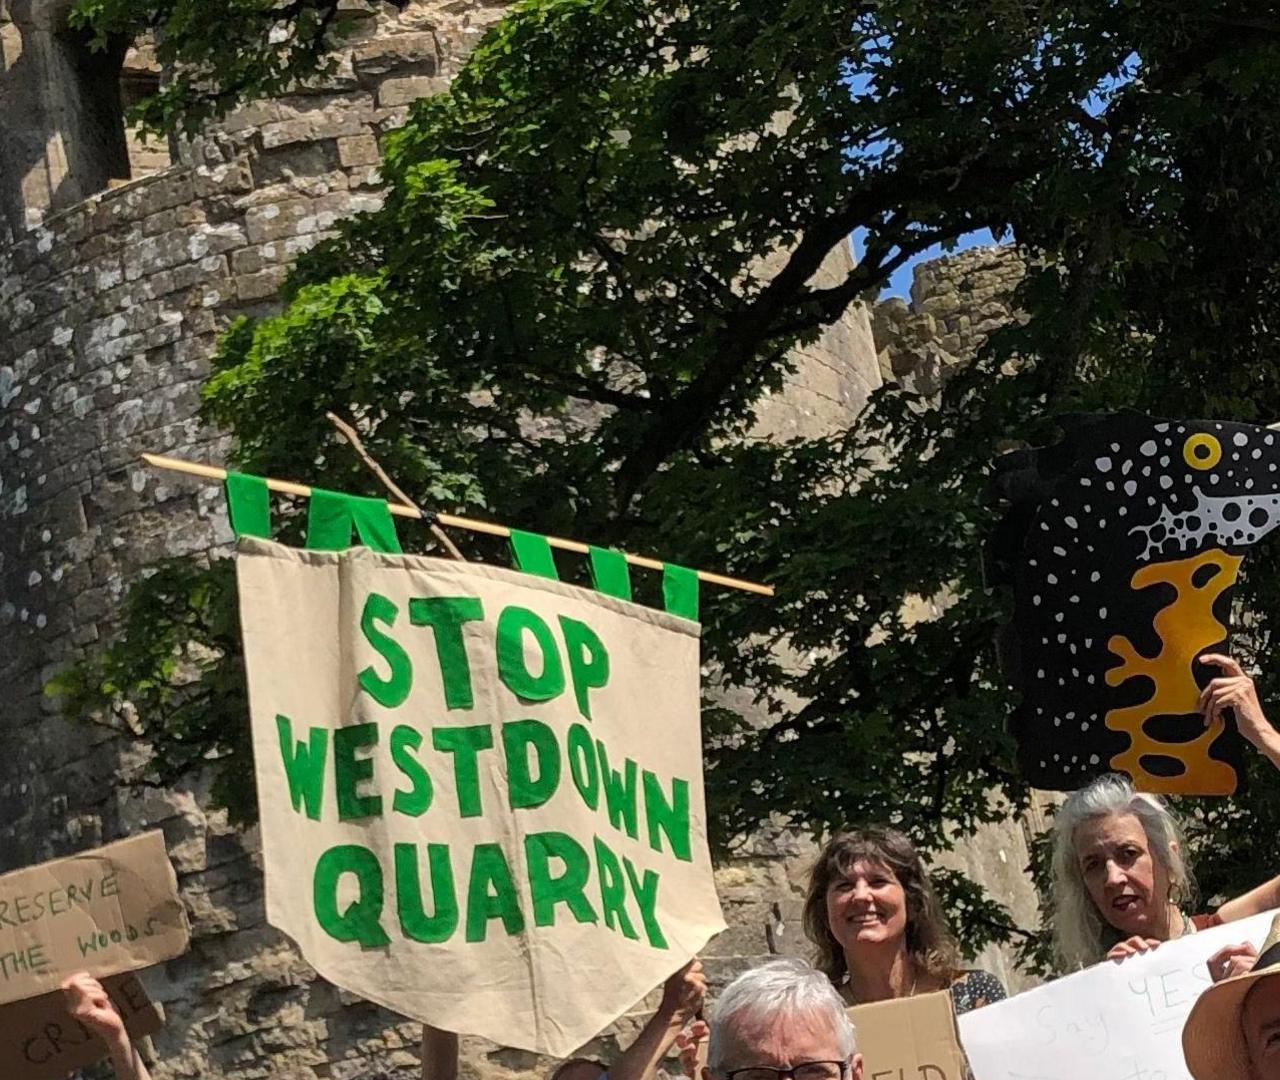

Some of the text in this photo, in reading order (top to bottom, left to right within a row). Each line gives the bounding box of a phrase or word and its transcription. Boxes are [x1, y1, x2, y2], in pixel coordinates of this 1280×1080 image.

[357, 592, 610, 720] STOP
[276, 713, 694, 862] WESTDOWN
[312, 831, 669, 951] QUARRY
[22, 976, 151, 1066] CRIE
